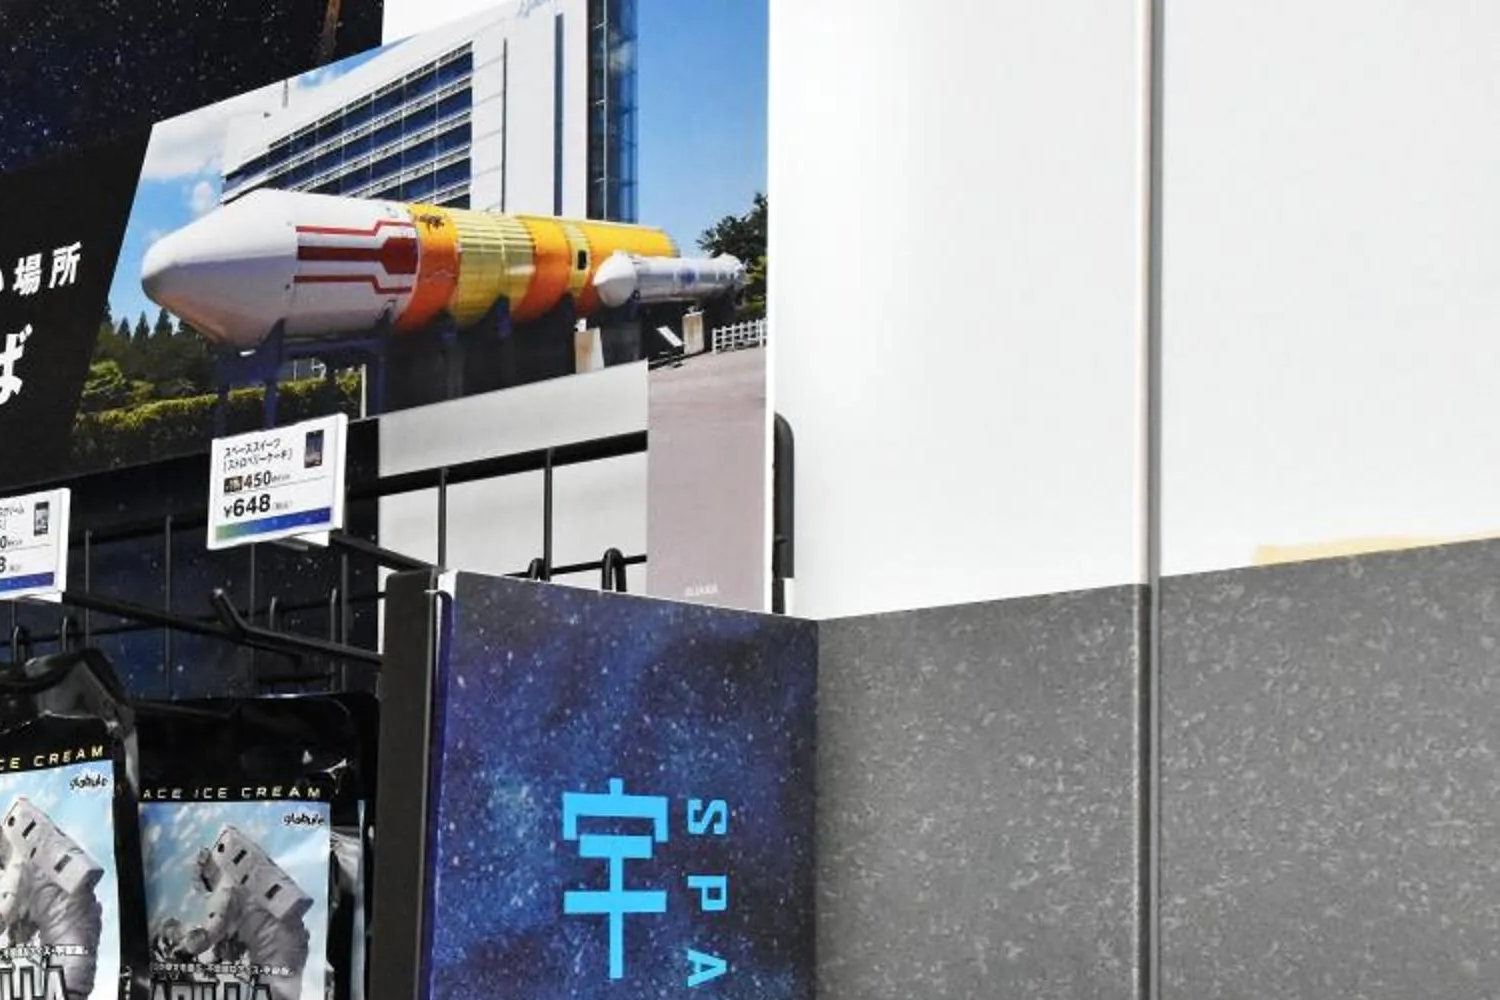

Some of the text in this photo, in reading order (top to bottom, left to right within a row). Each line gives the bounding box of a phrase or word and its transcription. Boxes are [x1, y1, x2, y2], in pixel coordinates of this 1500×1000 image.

[244, 470, 271, 488] 450
[224, 494, 271, 518] ¥648
[34, 745, 104, 768] CREAM
[143, 786, 321, 799] ACE ICE CREAM
